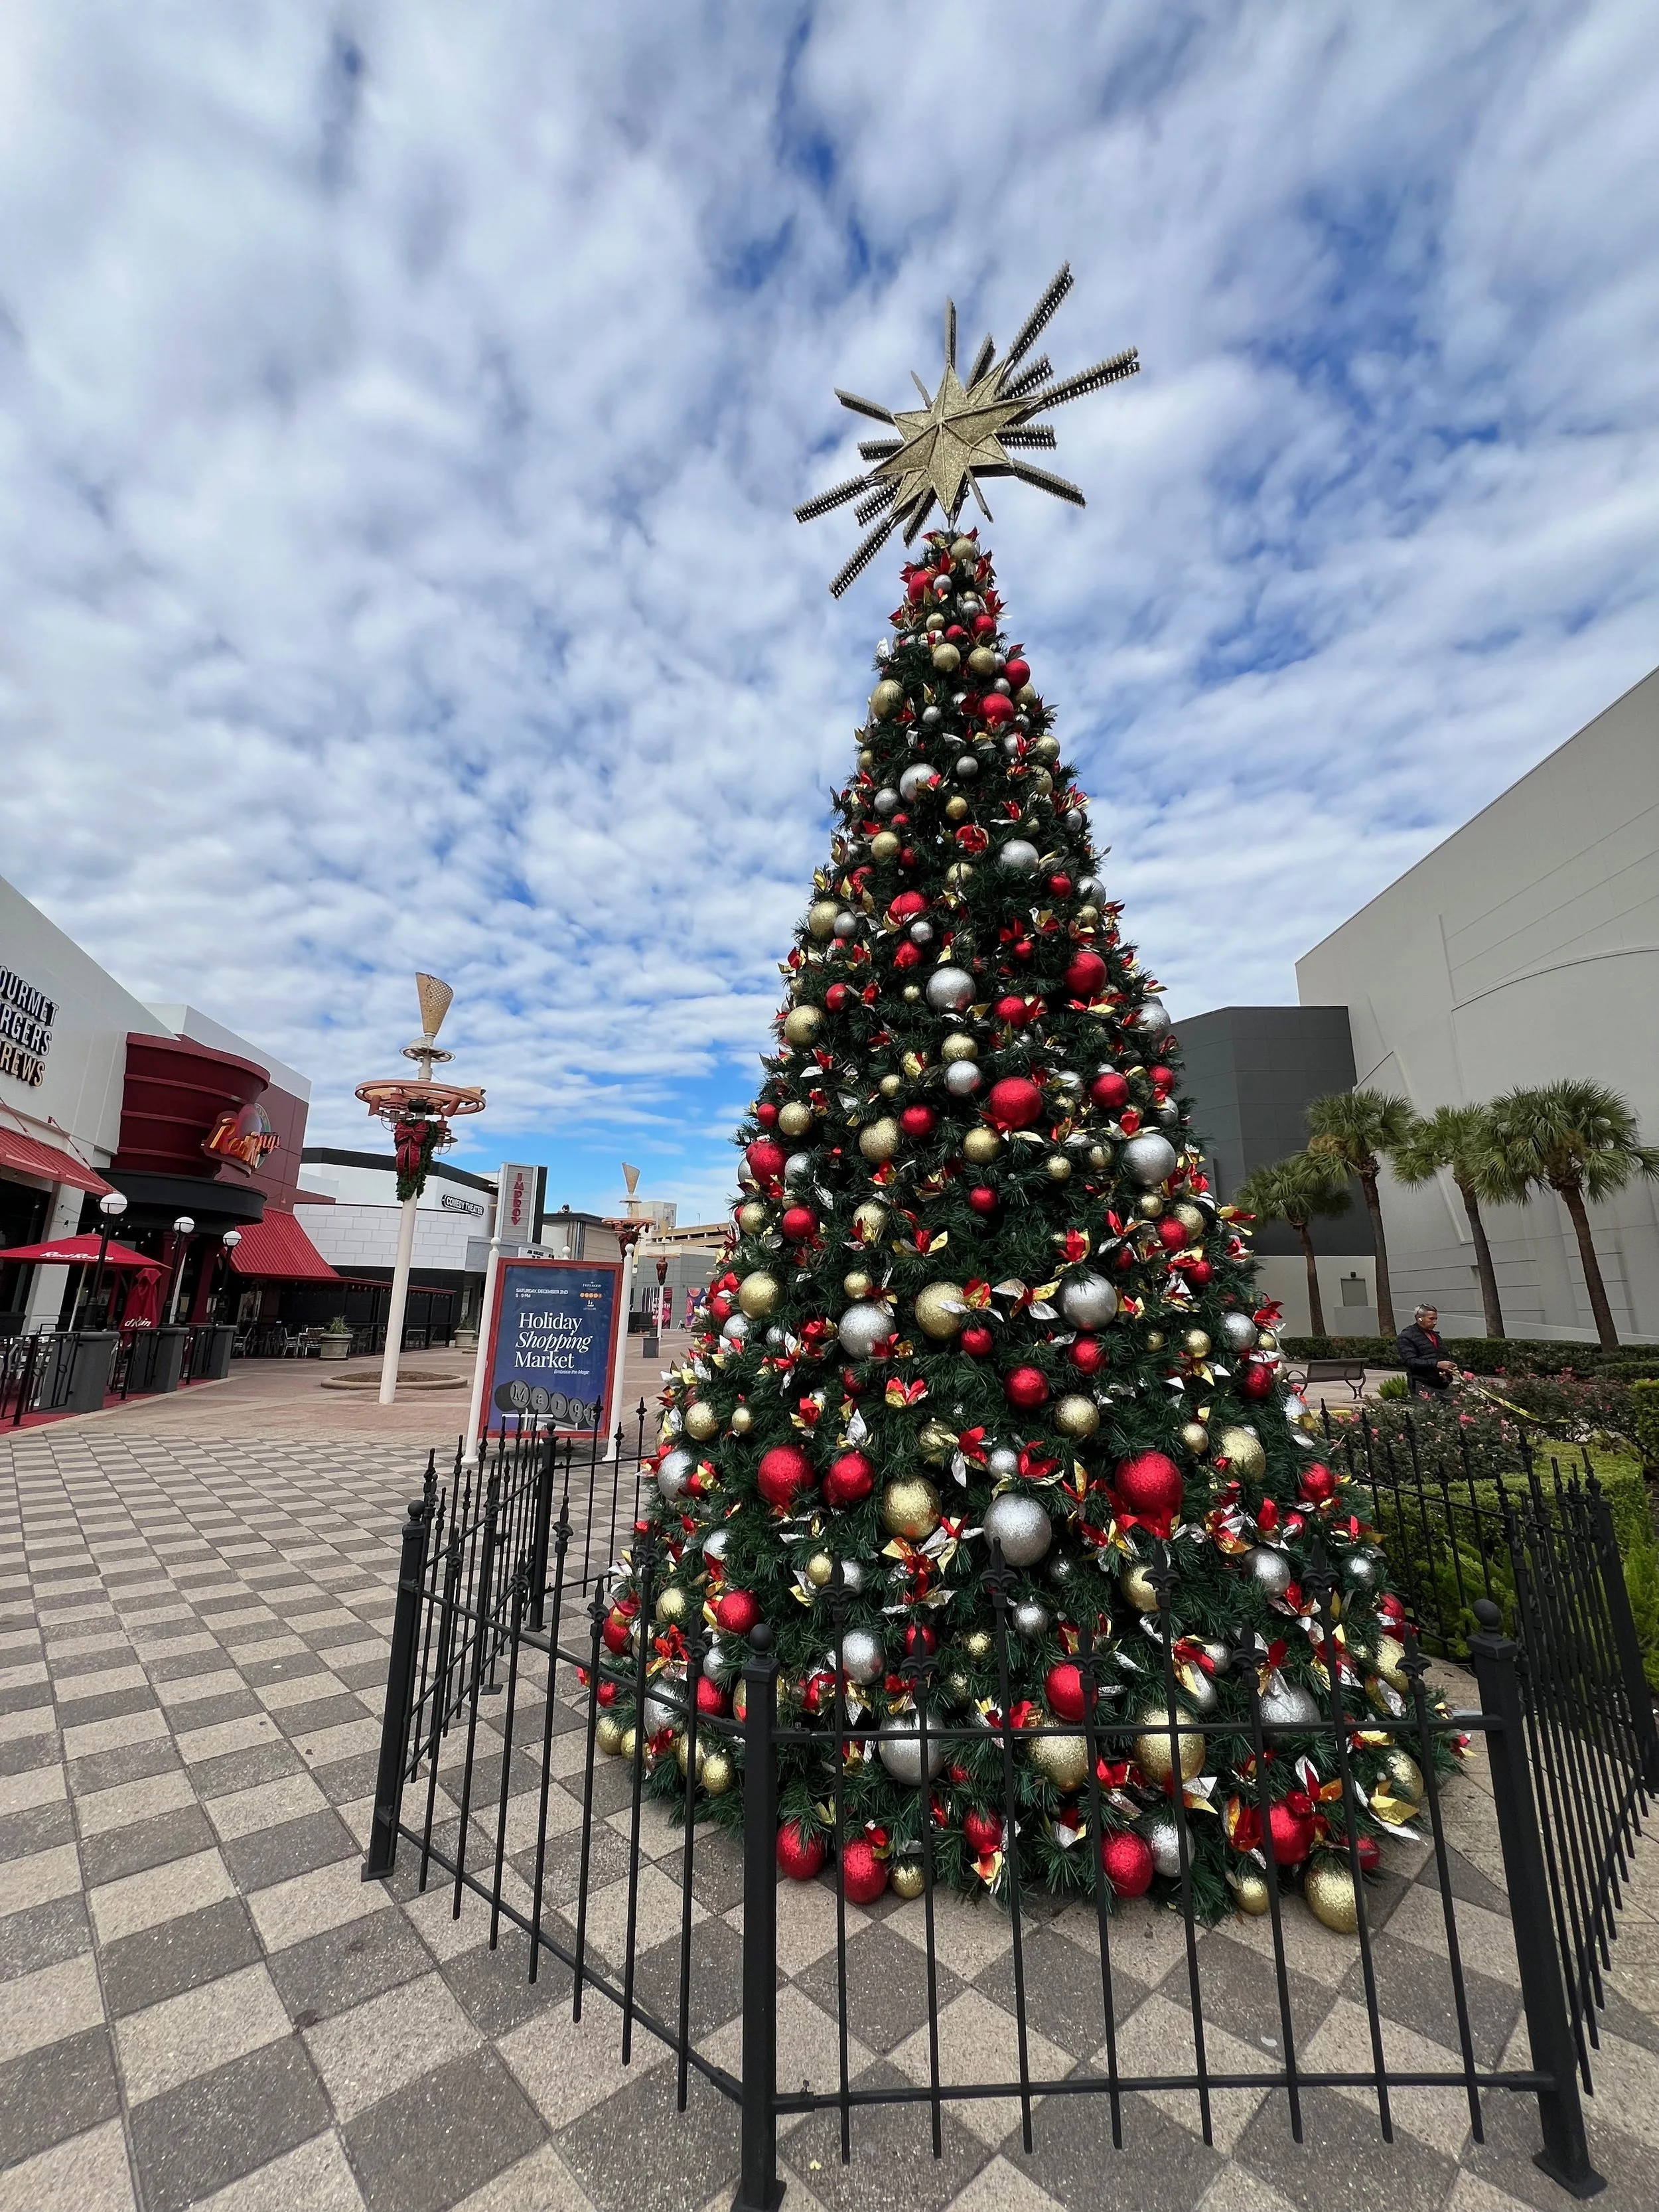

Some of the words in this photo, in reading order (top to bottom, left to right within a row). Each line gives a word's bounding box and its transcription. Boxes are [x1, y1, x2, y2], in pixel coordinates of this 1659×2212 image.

[0, 966, 60, 1027] OURMET
[0, 1001, 52, 1057] RGERS
[0, 1040, 45, 1087] REWS
[447, 1197, 465, 1209] COMEDY
[465, 1202, 483, 1215] THEATER
[511, 1173, 524, 1225] IMPROV
[518, 1311, 583, 1333] Holiday
[515, 1331, 593, 1353] Shopping
[514, 1351, 575, 1368] Market
